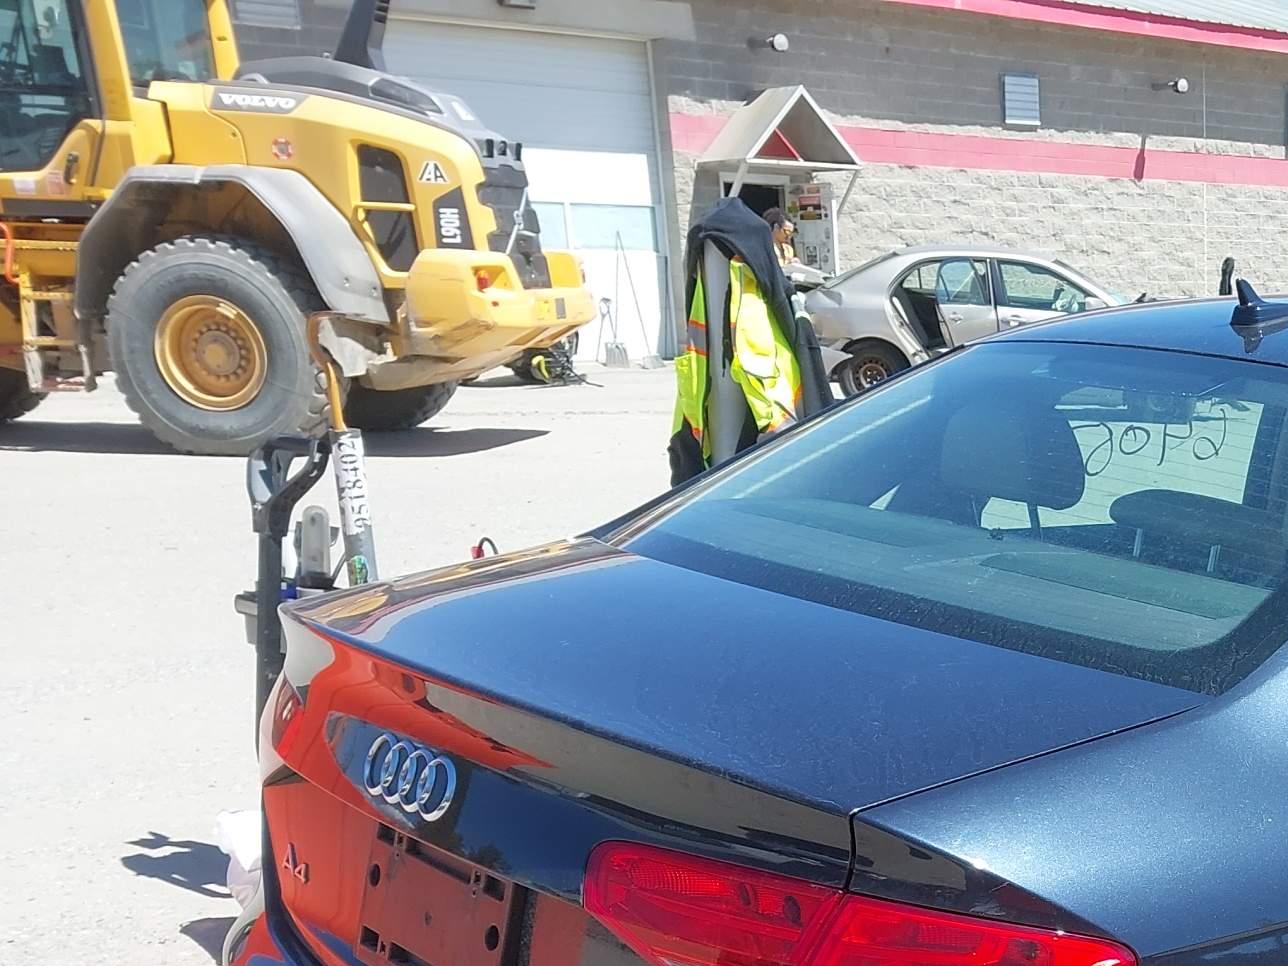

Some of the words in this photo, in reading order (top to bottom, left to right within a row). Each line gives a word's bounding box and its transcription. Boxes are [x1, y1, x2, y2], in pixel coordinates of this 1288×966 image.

[218, 92, 297, 109] VOLVO
[438, 207, 463, 244] L90H
[282, 842, 310, 885] A4
